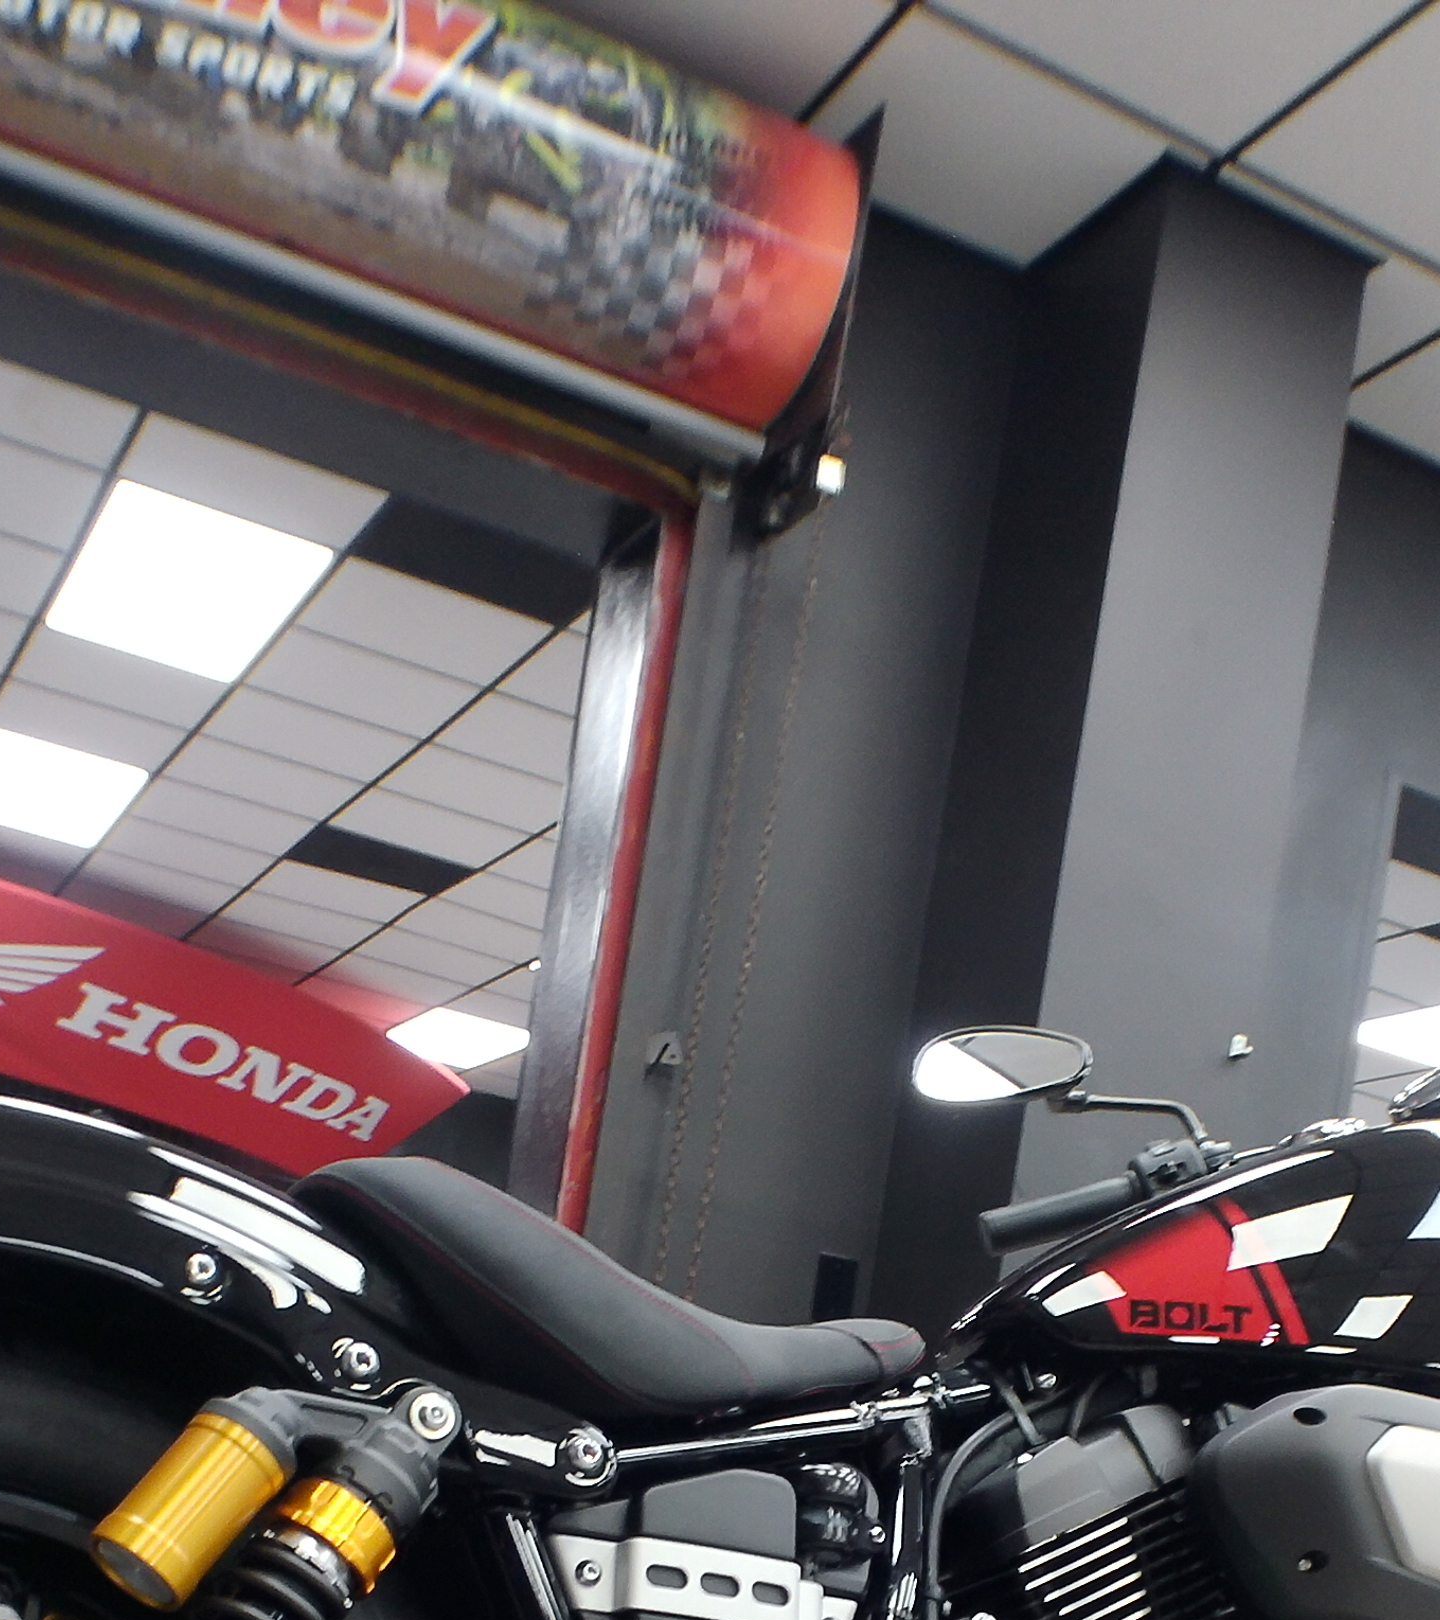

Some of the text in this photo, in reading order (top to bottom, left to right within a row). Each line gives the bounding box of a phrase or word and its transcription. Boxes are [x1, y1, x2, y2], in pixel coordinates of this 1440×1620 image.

[156, 20, 357, 120] SPORTS
[56, 982, 390, 1142] HONDA
[1129, 1299, 1253, 1334] BOLT
